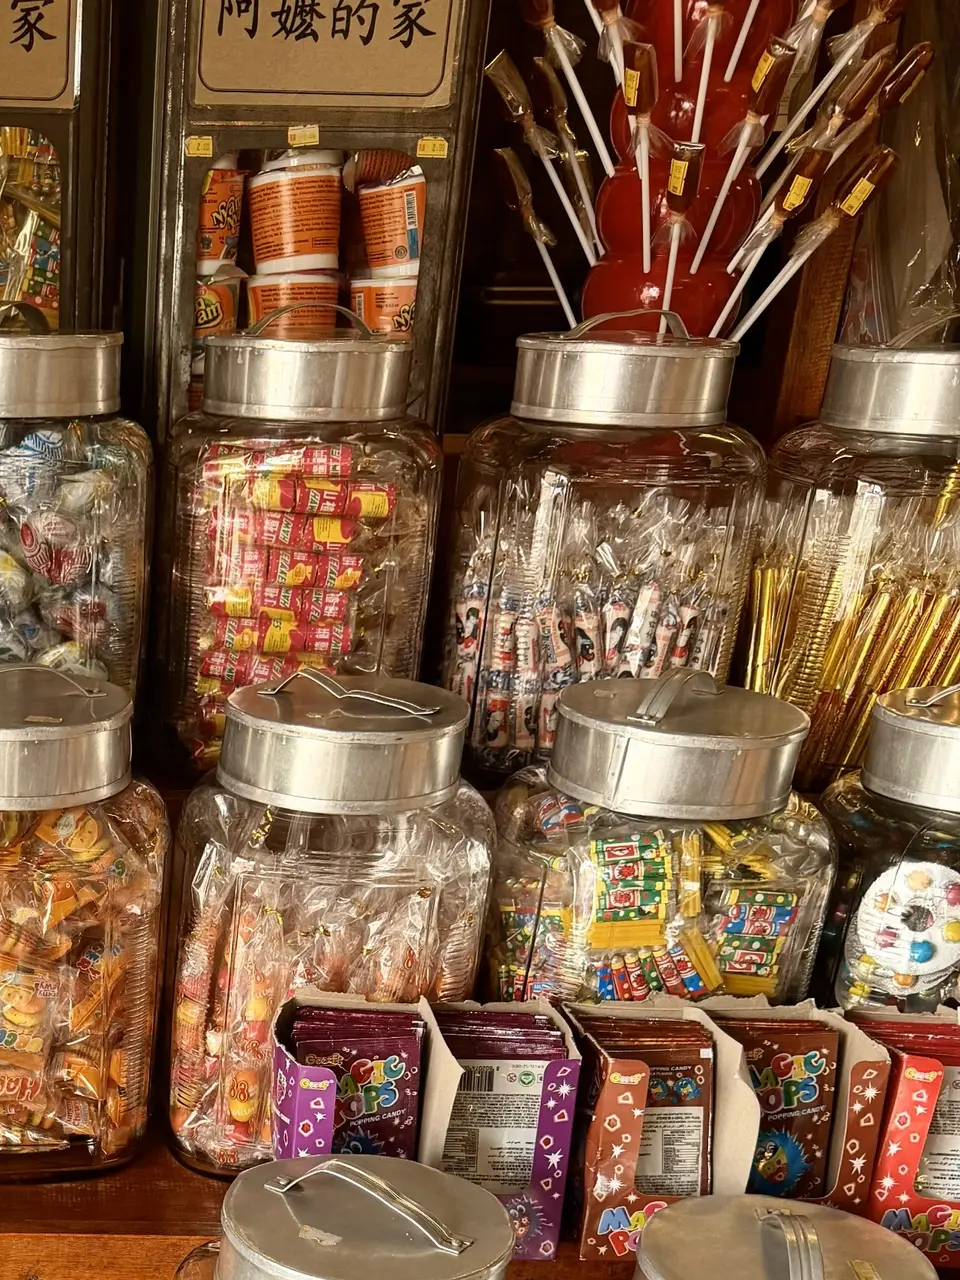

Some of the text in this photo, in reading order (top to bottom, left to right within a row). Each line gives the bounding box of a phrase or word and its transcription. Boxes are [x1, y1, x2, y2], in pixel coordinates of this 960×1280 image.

[336, 1055, 406, 1098] AGIC
[759, 1075, 819, 1114] OPS
[381, 1107, 407, 1120] CANDY
[801, 1104, 827, 1115] CANDY
